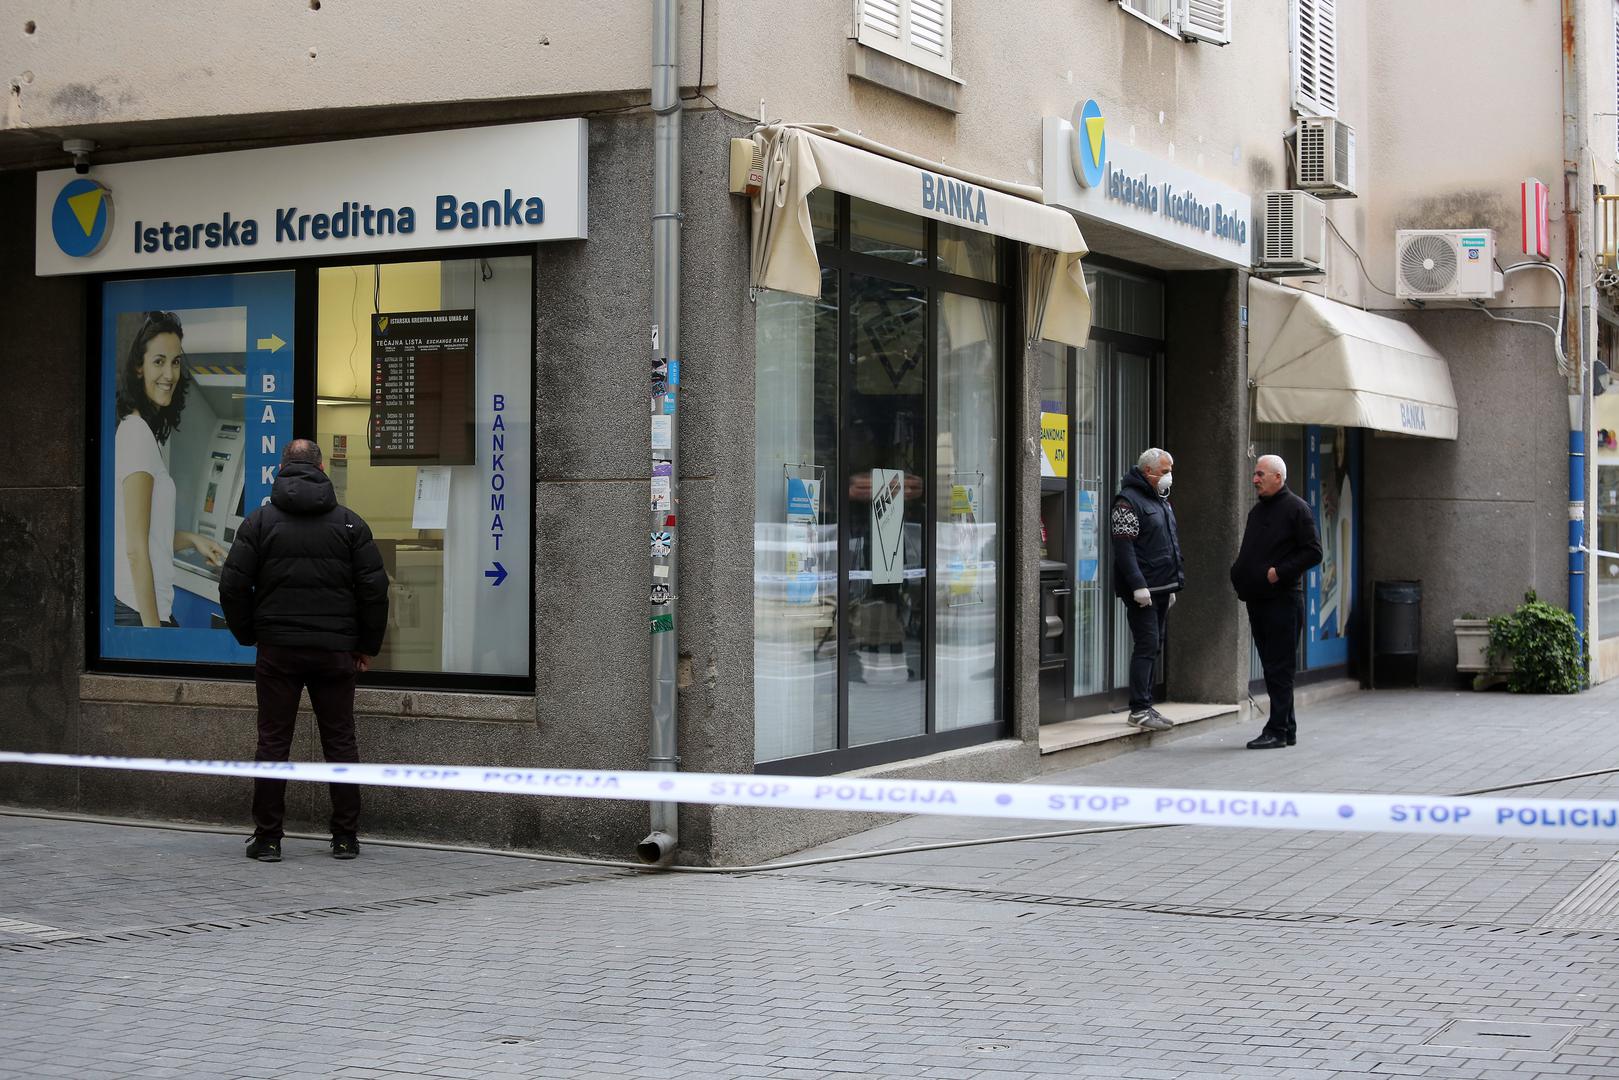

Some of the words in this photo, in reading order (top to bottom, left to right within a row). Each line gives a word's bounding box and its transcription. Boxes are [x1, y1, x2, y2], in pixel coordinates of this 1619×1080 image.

[134, 211, 258, 254] Istarska
[275, 201, 415, 242] Kreditna
[435, 188, 544, 231] Banka
[921, 171, 989, 226] BANKA
[1105, 160, 1158, 214] Istarska
[1160, 182, 1211, 232] Kreditna
[1215, 203, 1247, 246] Banka
[376, 338, 403, 346] TEČAJNA
[1400, 402, 1426, 431] BANKA
[490, 394, 506, 551] BANKOMAT
[1055, 448, 1065, 462] ATM
[380, 766, 460, 783] STOP
[482, 769, 621, 790] POLICIJA
[710, 780, 790, 800] STOP
[814, 783, 958, 806] POLICIJA
[1048, 793, 1130, 813] STOP
[1155, 796, 1299, 818] POLICIJA
[1390, 803, 1472, 823] STOP
